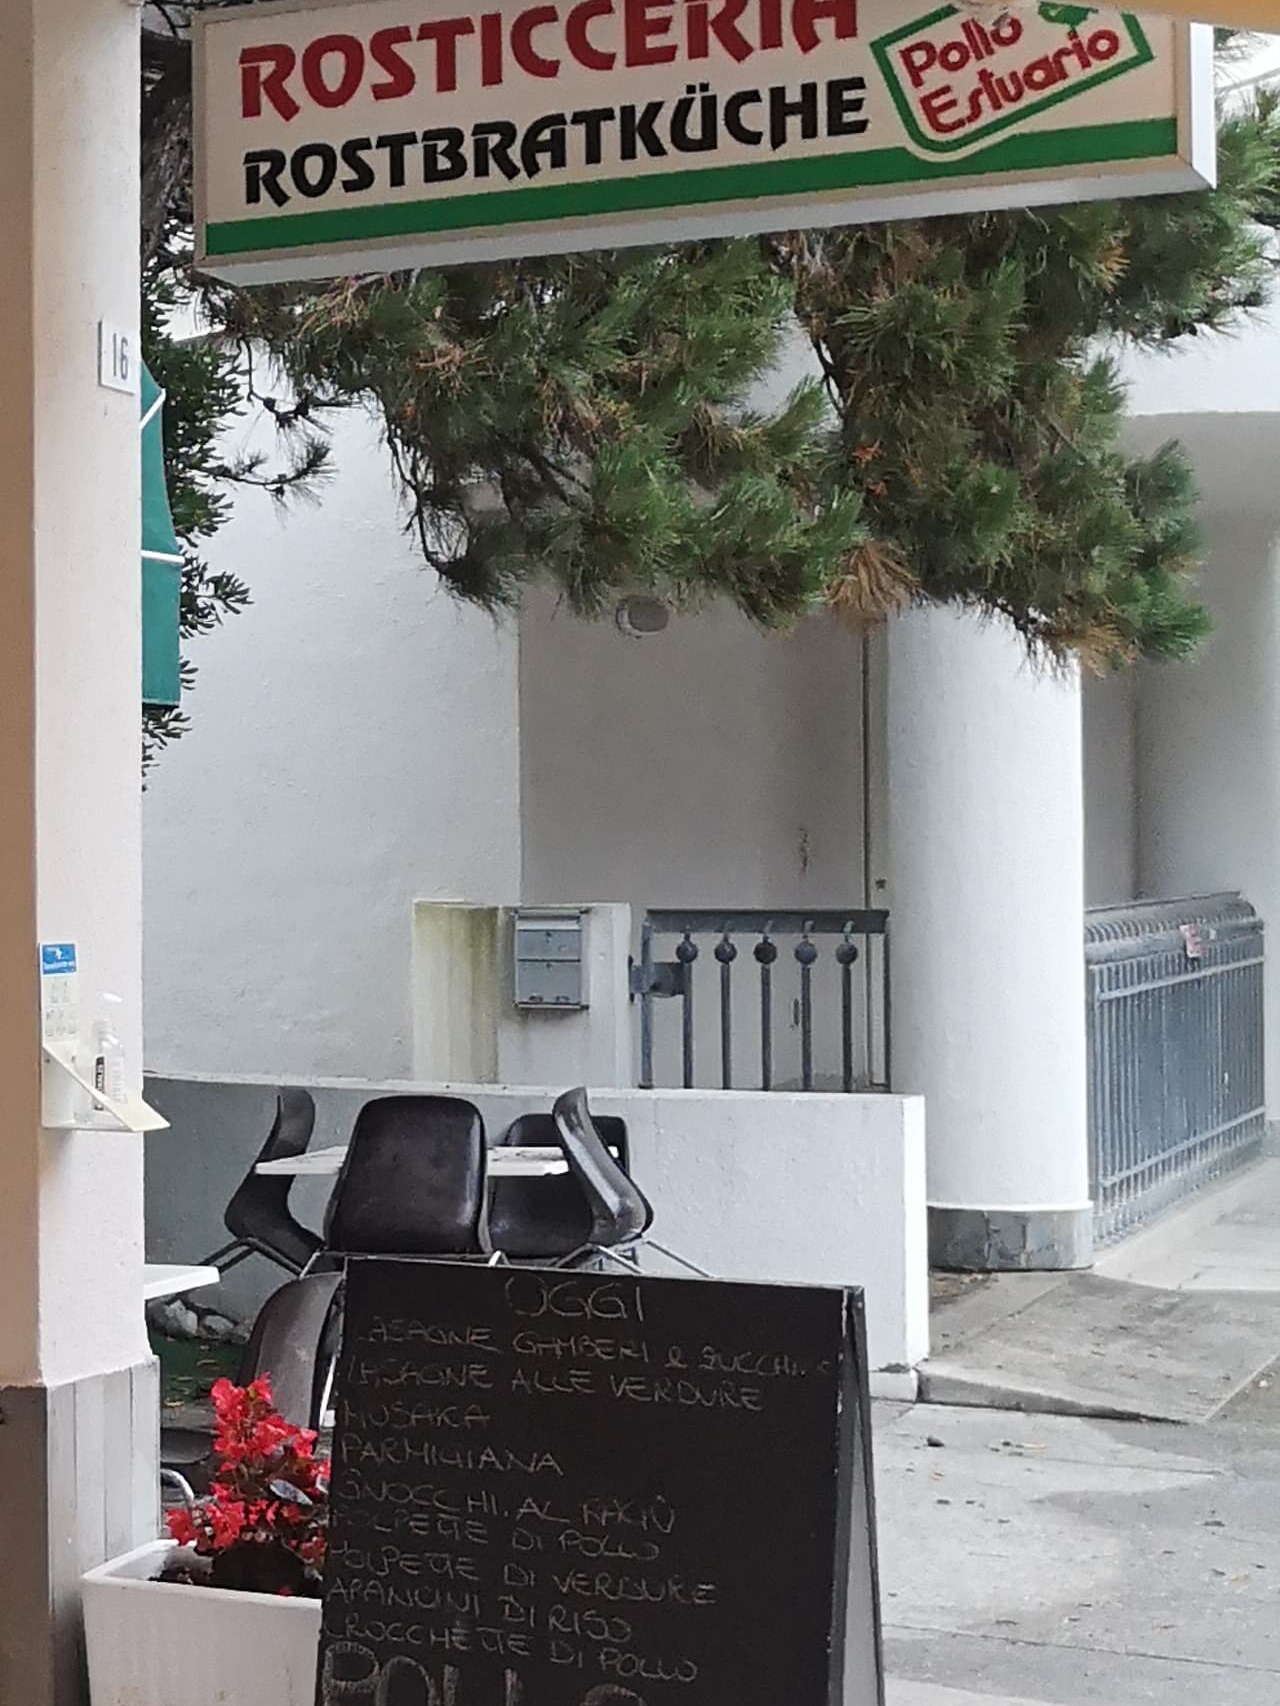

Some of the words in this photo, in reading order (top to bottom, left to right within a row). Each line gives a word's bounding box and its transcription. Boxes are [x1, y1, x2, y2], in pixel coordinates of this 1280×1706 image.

[899, 12, 1024, 89] Pollo
[920, 28, 1120, 133] Estuario
[243, 76, 871, 208] ROSTBRATKÜCHE
[111, 332, 129, 381] 16
[505, 1275, 646, 1321] OGGI
[511, 1367, 596, 1394] ALLE
[609, 1373, 763, 1412] VERDURE
[511, 1527, 543, 1552] DI
[502, 1562, 538, 1588] DI
[548, 1604, 633, 1643] RISO
[549, 1640, 584, 1668] DI
